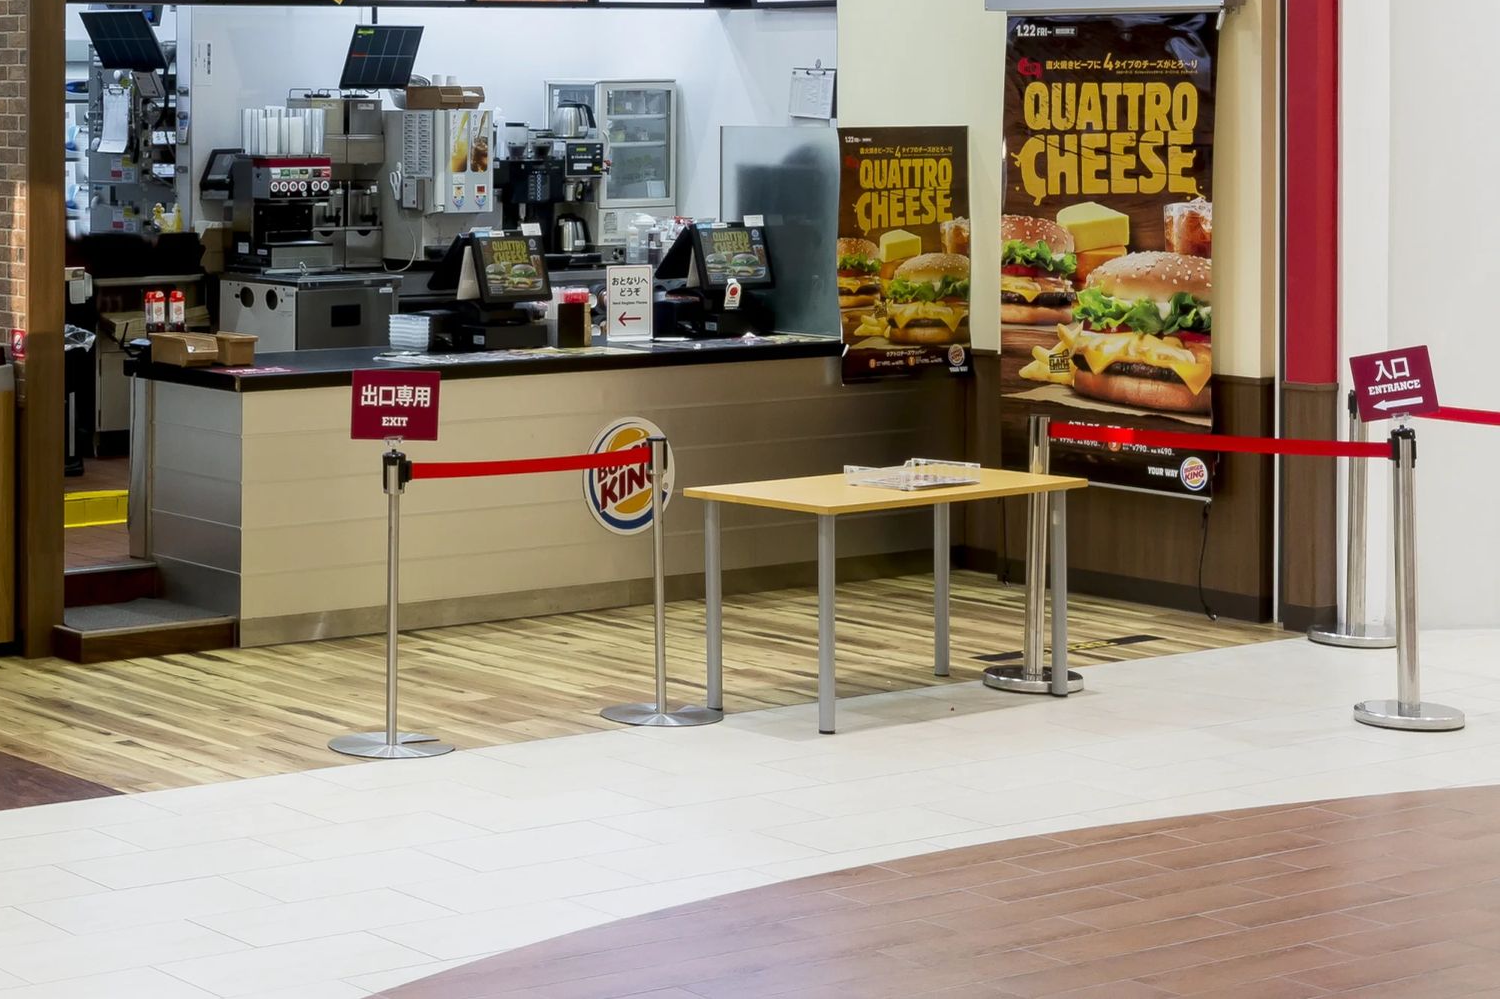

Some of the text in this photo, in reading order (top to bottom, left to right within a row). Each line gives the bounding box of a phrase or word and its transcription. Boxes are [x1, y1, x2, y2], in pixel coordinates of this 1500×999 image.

[1016, 24, 1036, 37] 1.22
[1024, 82, 1198, 131] QUATTRO
[859, 158, 953, 189] QUATTRO
[1012, 130, 1202, 204] CHEESE
[854, 187, 953, 234] CHEESE
[713, 231, 749, 242] QUATTRO
[492, 240, 527, 251] QUATTRO
[612, 276, 648, 286] おとなりへ
[620, 287, 641, 297] どうぞ
[1375, 357, 1410, 382] 入口
[1368, 379, 1421, 396] ENTRANCE
[361, 384, 431, 407] 出口専用
[382, 417, 408, 426] EXIT
[1148, 466, 1179, 478] YOUR WAY
[1185, 469, 1205, 481] KING
[601, 462, 652, 511] KIN
